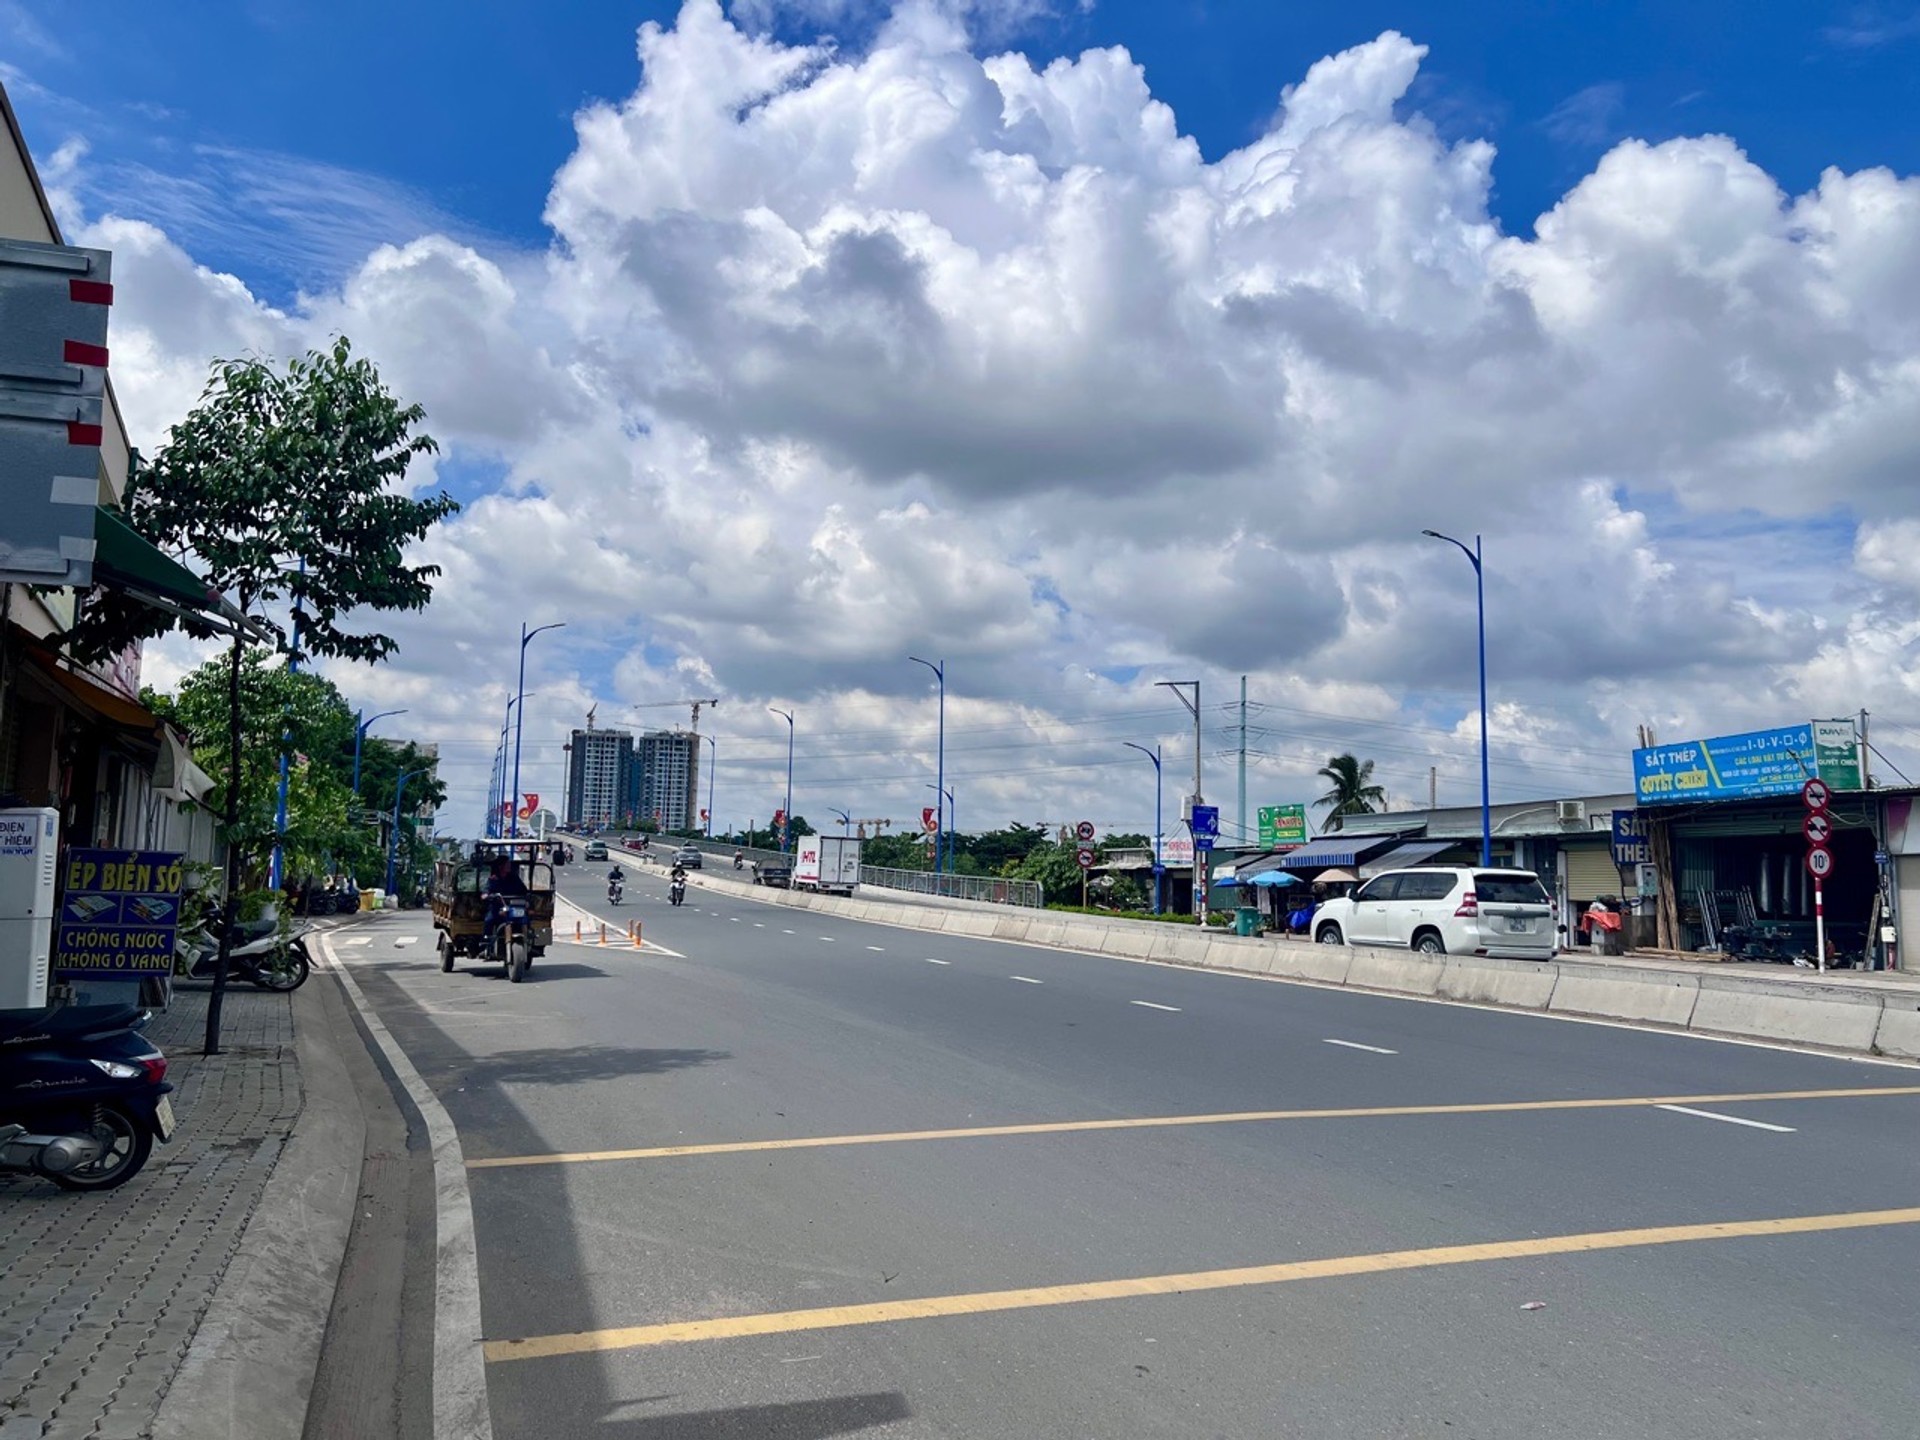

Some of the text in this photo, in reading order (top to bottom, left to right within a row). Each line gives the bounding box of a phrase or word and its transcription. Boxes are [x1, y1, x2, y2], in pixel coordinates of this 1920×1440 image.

[1667, 747, 1697, 764] THÉP
[101, 852, 151, 892] BIỂN
[155, 856, 183, 893] SỐ
[58, 950, 111, 968] KHÔNG
